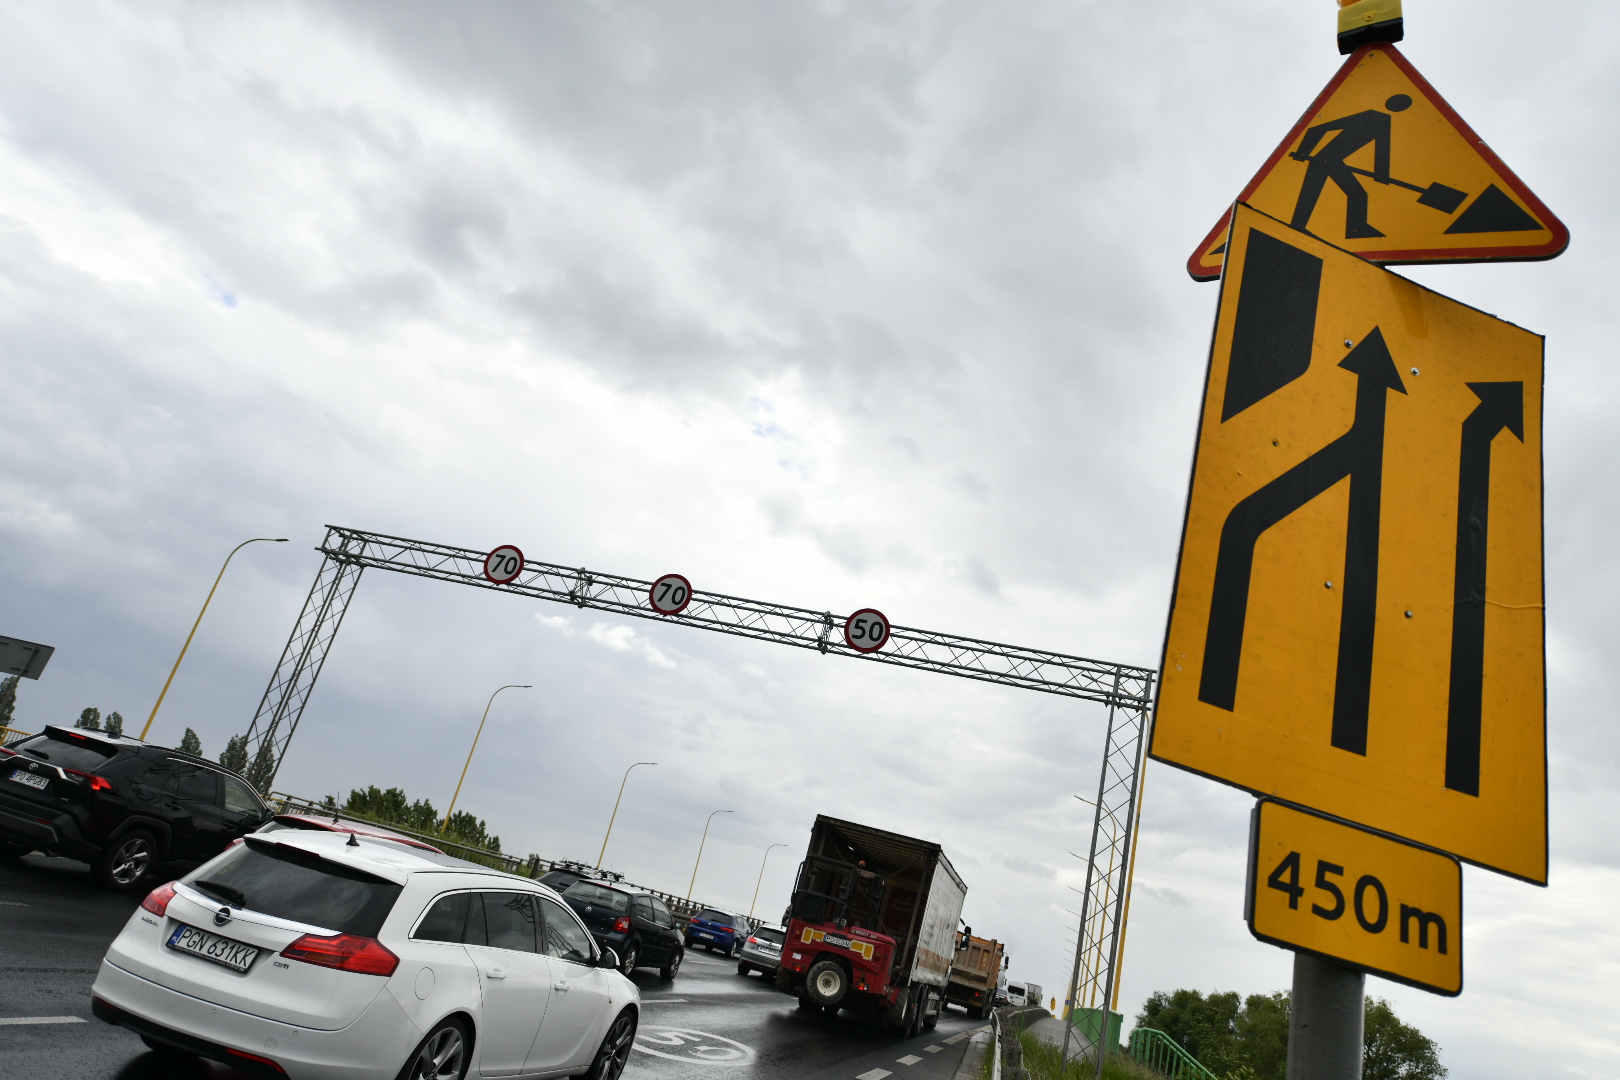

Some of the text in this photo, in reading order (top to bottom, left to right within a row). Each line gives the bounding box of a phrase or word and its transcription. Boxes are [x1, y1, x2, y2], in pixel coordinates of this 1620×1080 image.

[491, 553, 518, 575] 70
[657, 582, 686, 606] 70
[851, 618, 884, 642] 50
[1267, 850, 1448, 956] 450 m
[177, 928, 211, 952] PGN
[206, 939, 256, 967] 631KK
